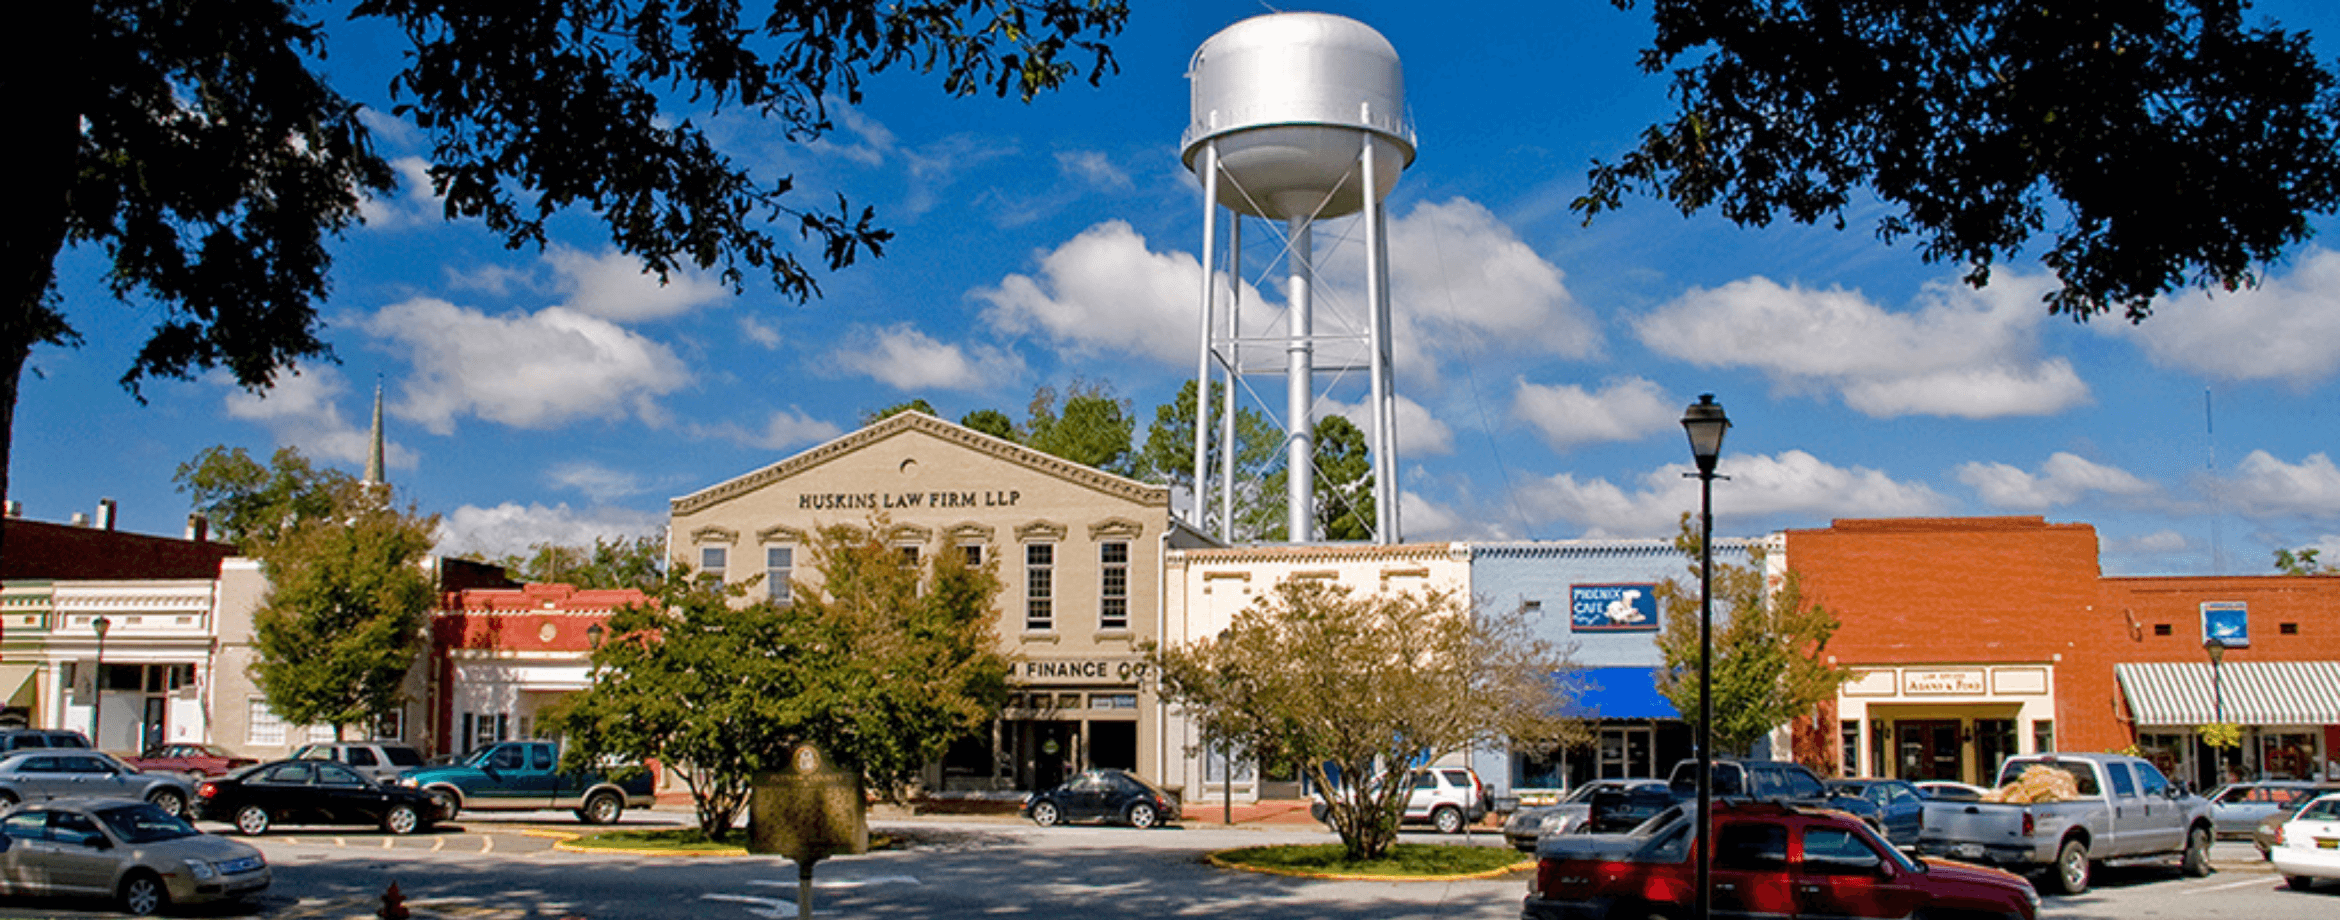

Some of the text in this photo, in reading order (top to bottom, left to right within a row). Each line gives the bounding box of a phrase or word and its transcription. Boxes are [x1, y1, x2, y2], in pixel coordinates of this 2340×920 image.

[798, 490, 1021, 509] HUSKINS LAW FIRM LLP
[1026, 662, 1107, 677] FINANCE
